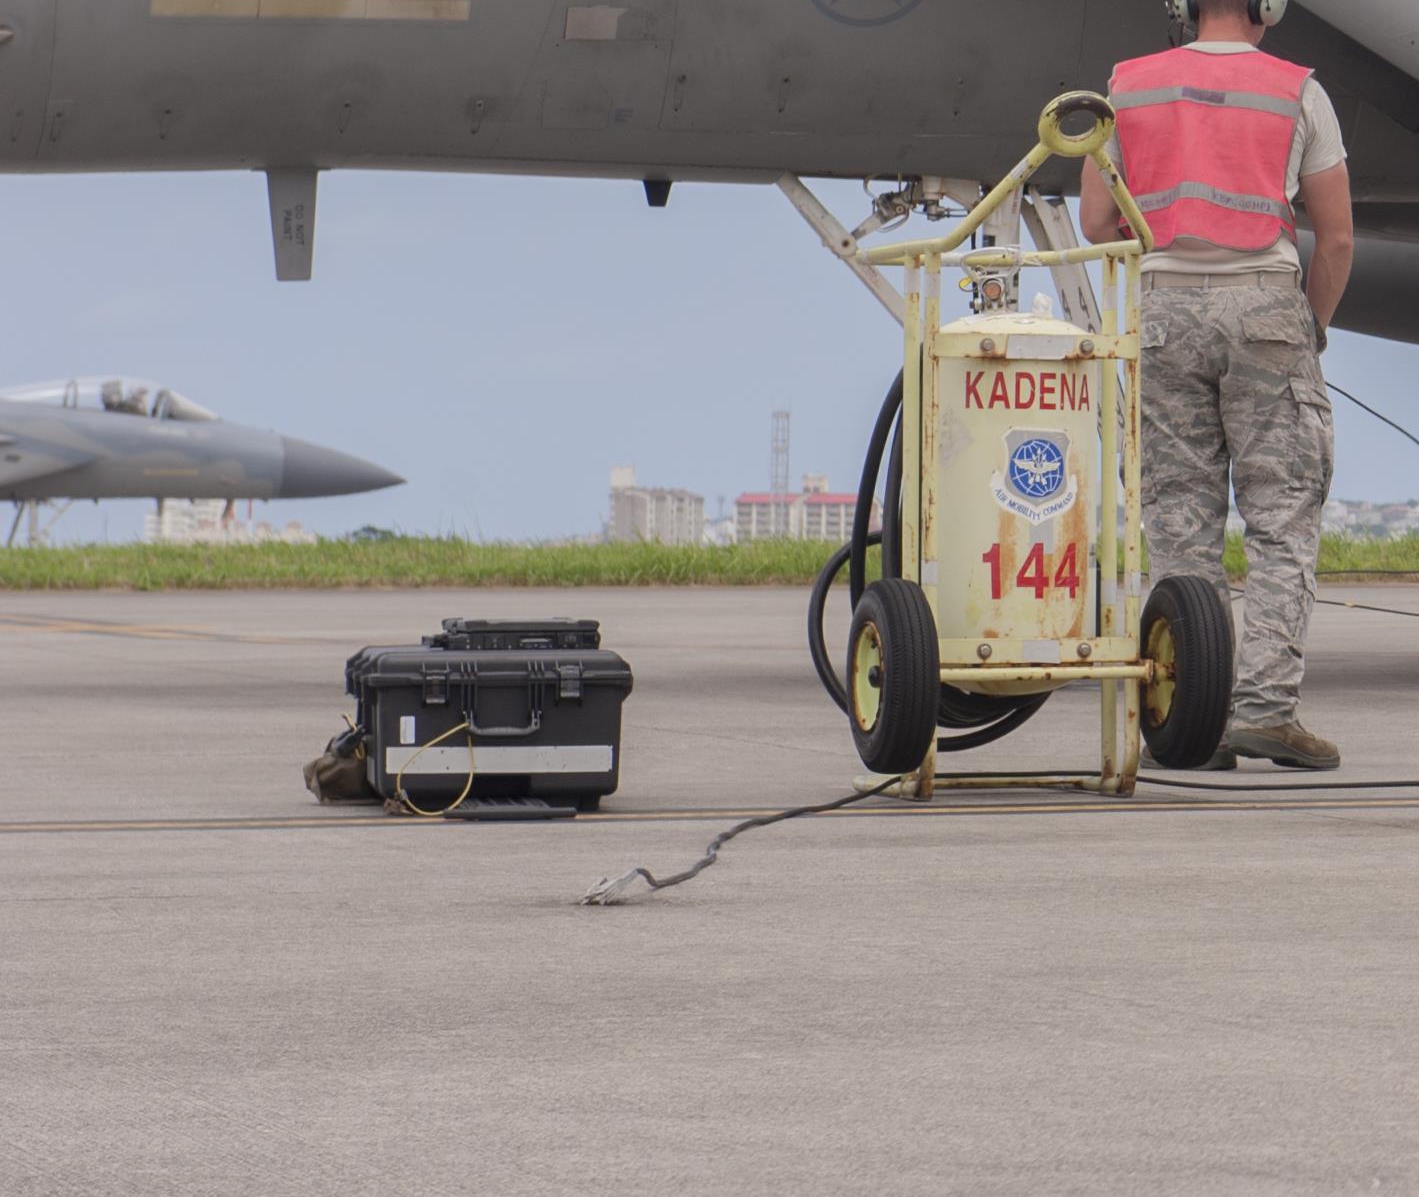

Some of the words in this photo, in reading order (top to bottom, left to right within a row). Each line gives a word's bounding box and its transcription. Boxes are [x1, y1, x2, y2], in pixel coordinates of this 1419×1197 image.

[295, 204, 305, 220] DO
[295, 224, 305, 246] NOT
[965, 370, 1090, 412] KADENA
[994, 488, 1008, 503] AIR
[1007, 499, 1041, 521] MOBILITY
[982, 542, 1081, 600] 144
